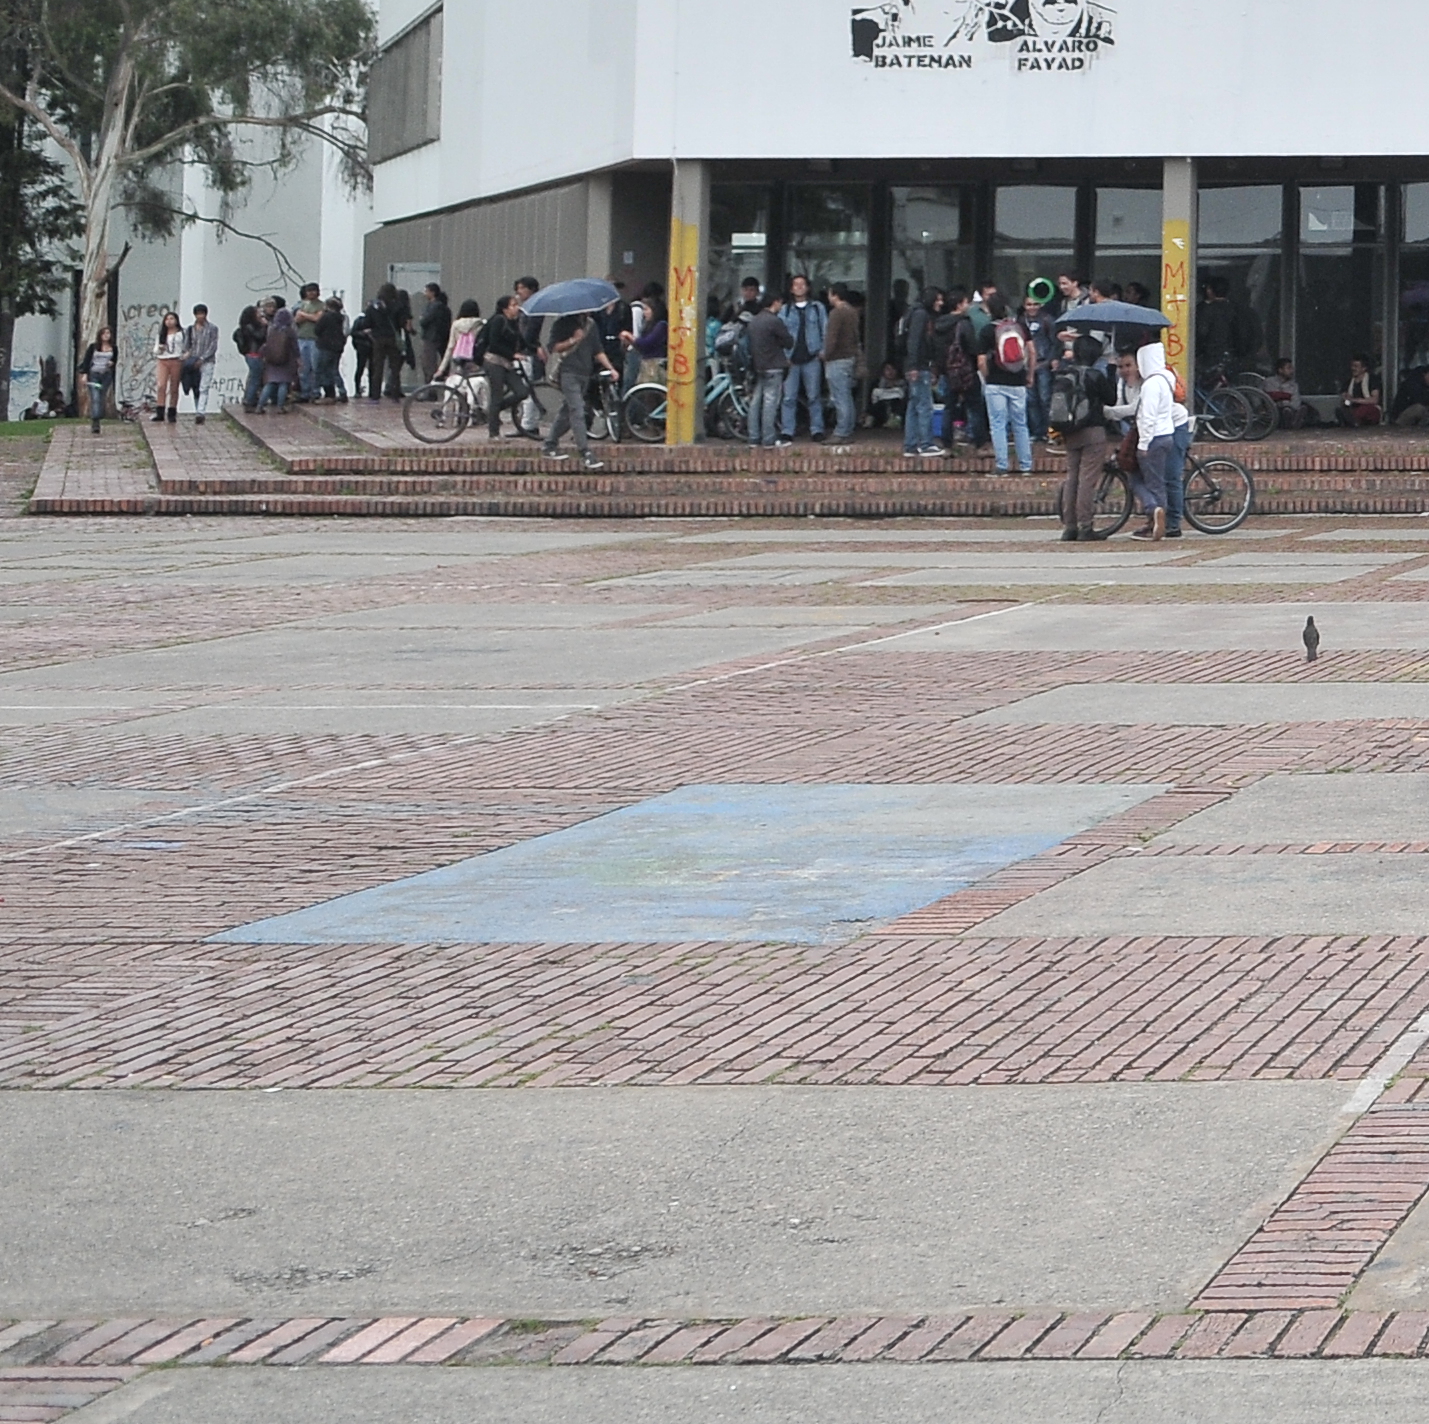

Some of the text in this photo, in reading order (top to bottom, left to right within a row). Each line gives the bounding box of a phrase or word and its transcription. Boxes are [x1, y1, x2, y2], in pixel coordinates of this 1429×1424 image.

[874, 34, 935, 49] JAIME
[1017, 39, 1099, 53] ALVARO
[874, 53, 972, 69] BATEMAN
[1017, 56, 1085, 72] FAYAD
